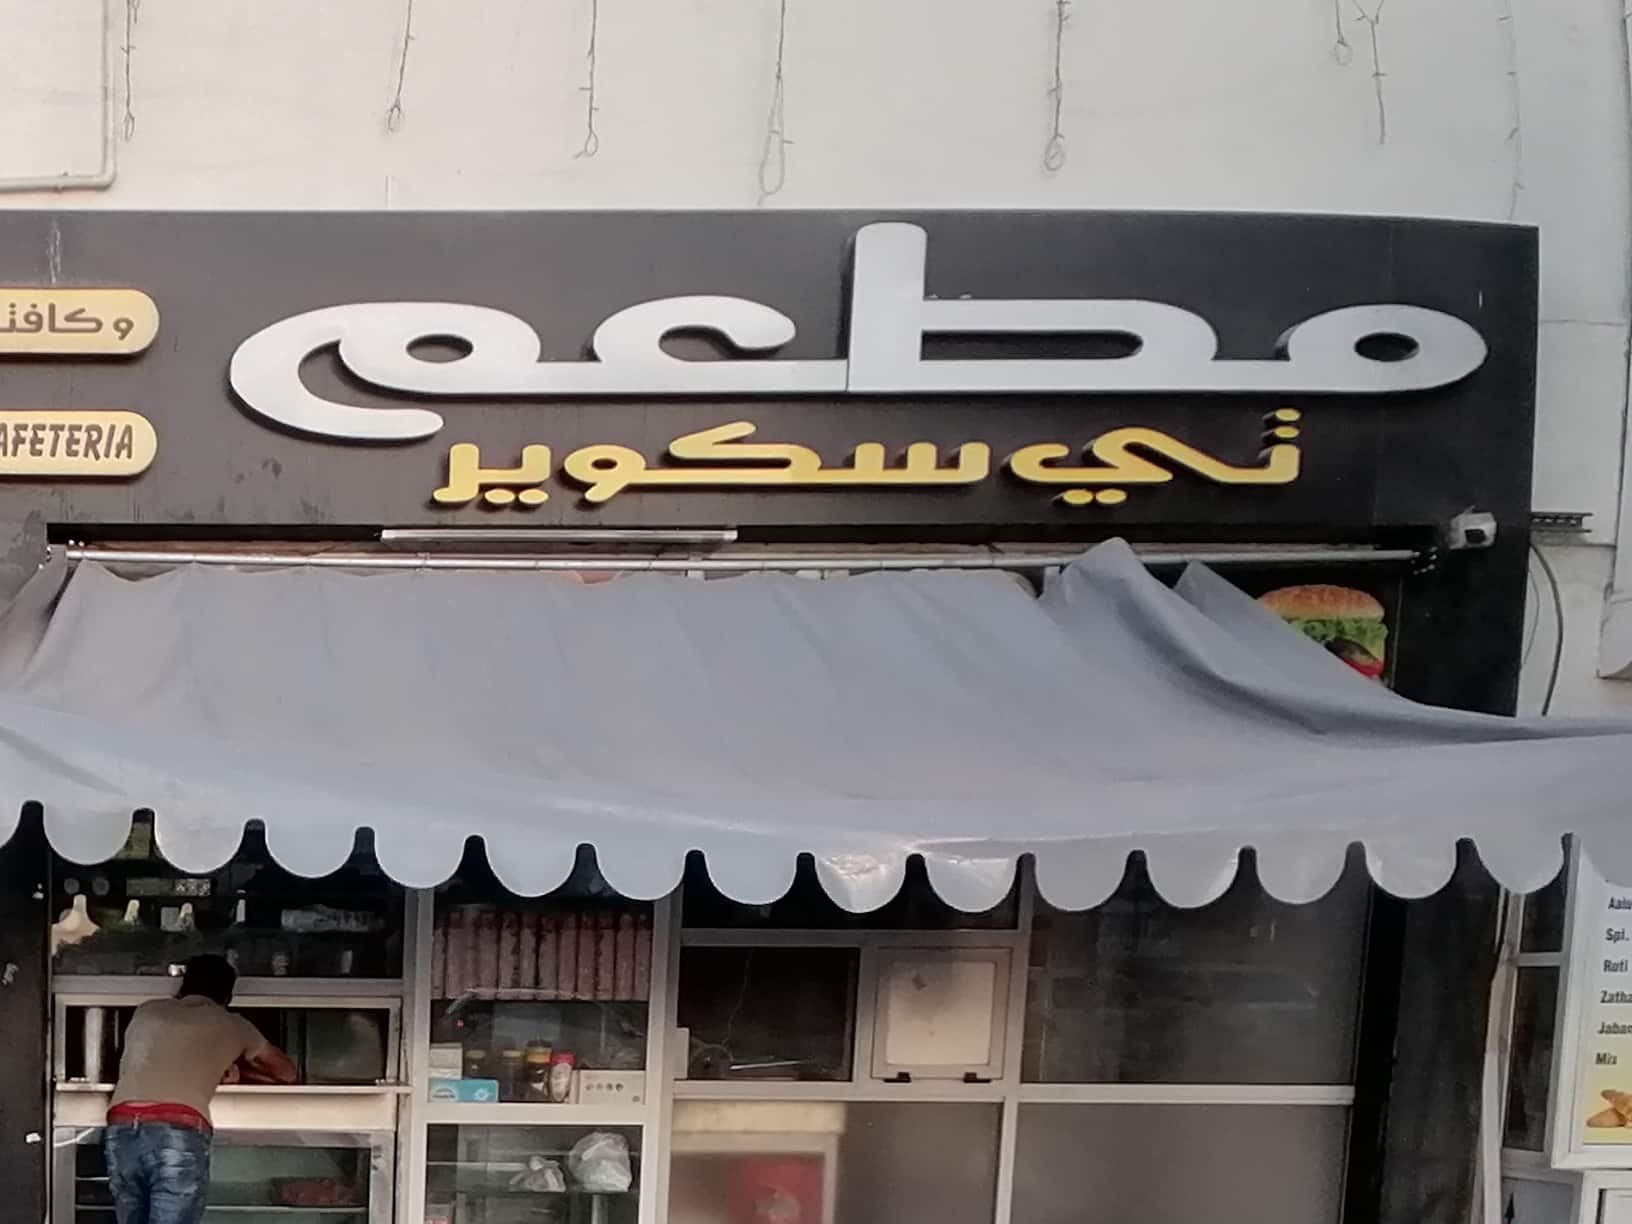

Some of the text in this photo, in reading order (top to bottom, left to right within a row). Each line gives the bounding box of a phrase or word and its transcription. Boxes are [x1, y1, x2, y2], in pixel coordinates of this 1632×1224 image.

[230, 222, 1489, 441] مطعم
[433, 408, 1302, 505] تي سكوير
